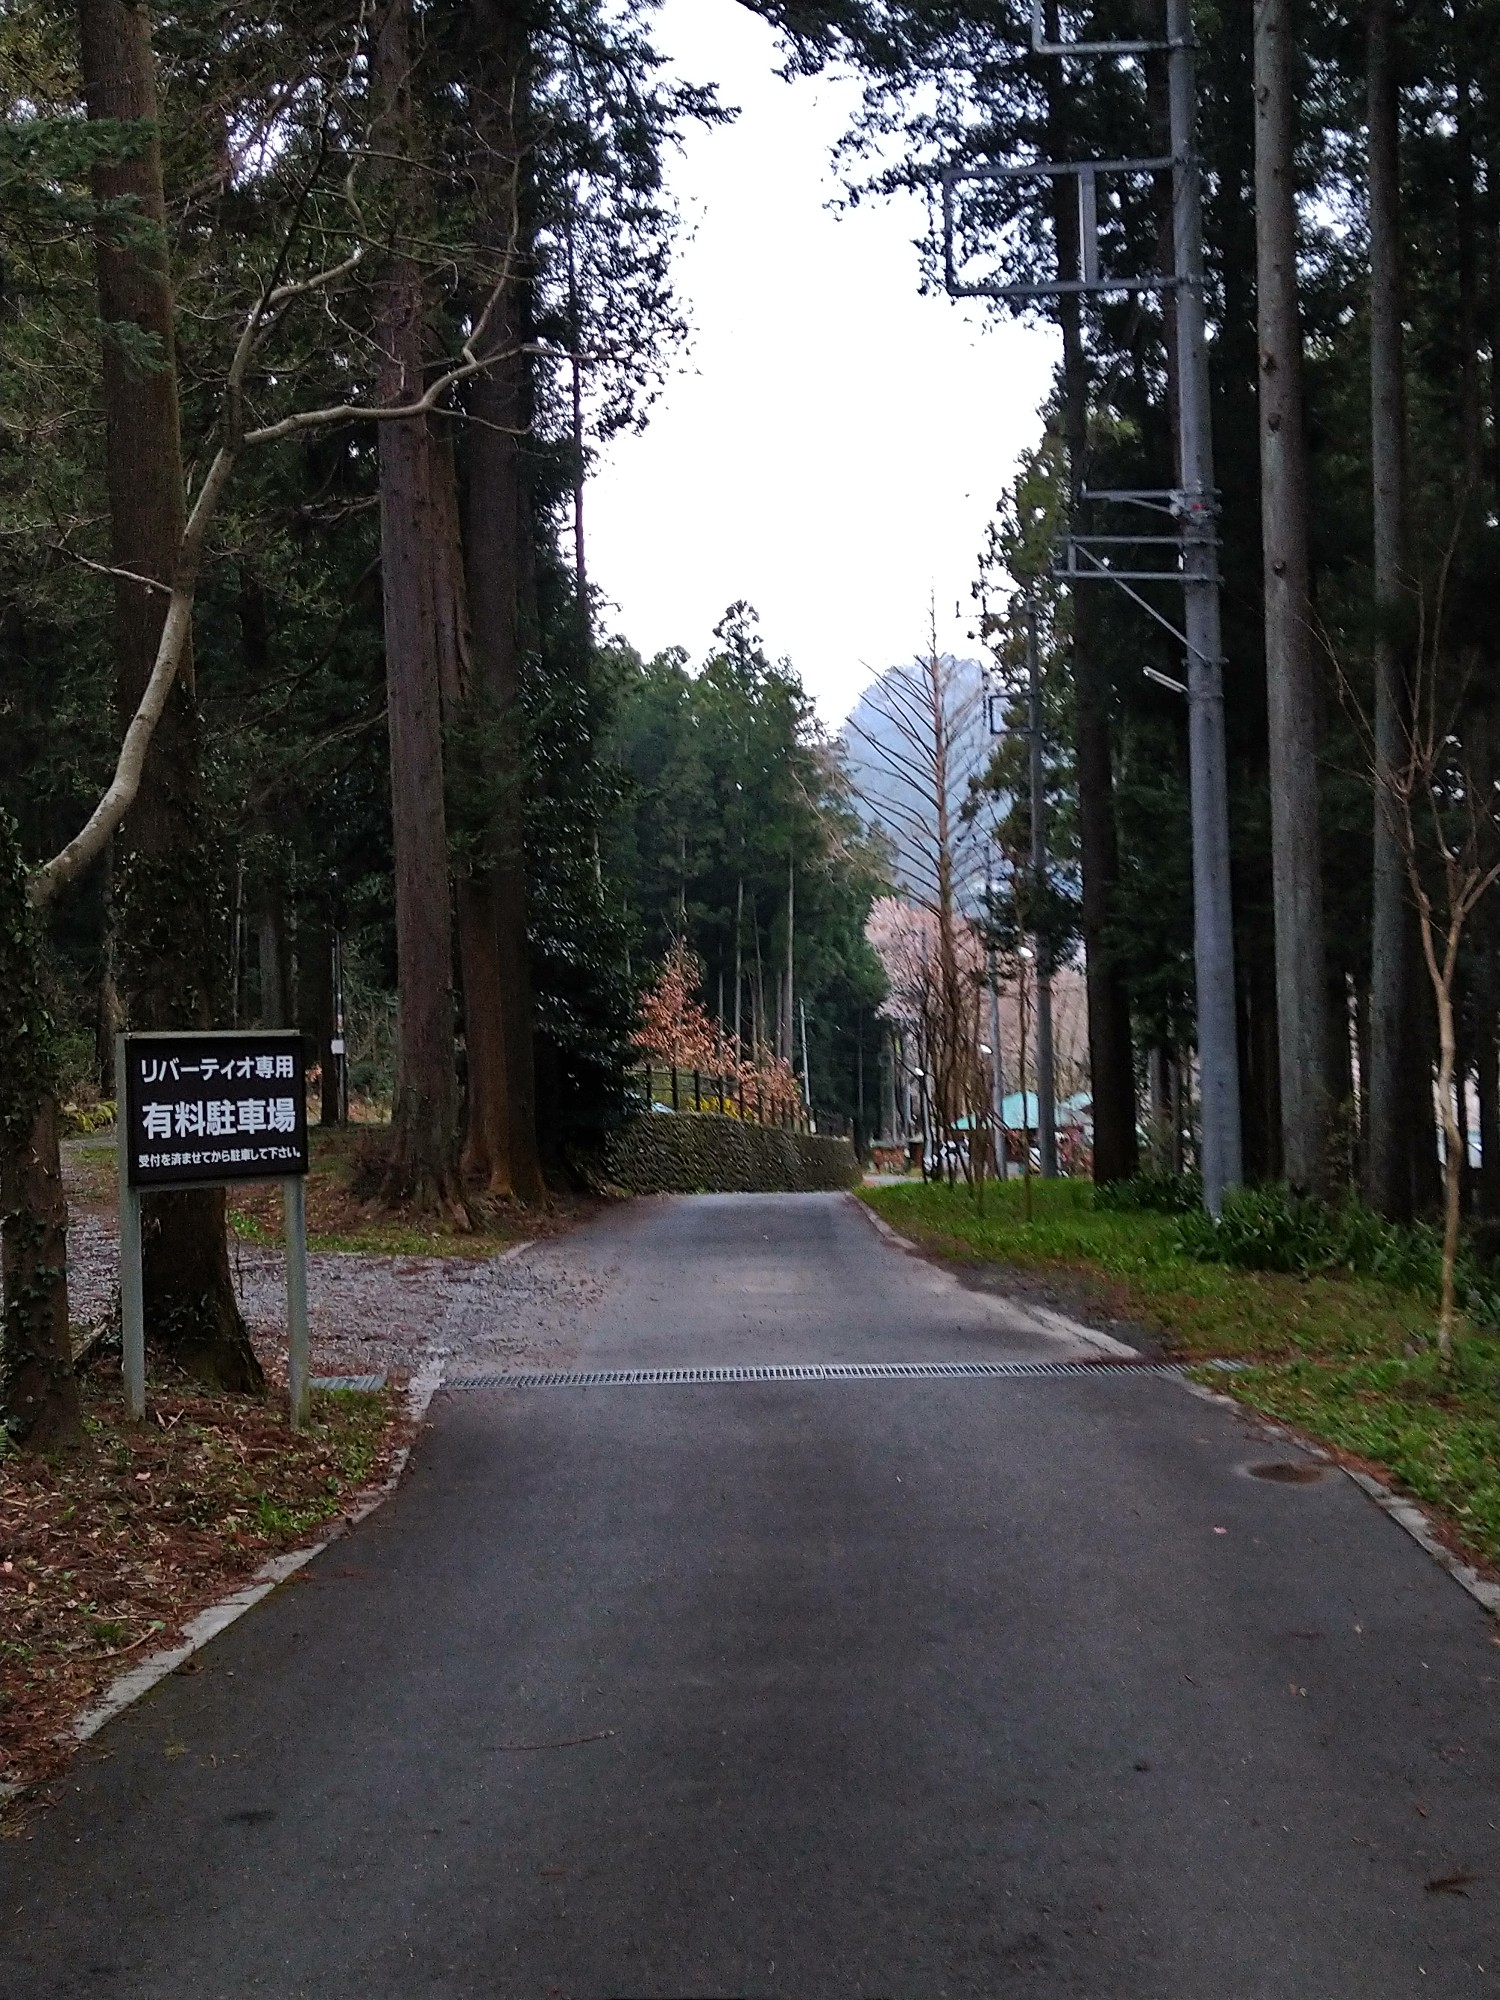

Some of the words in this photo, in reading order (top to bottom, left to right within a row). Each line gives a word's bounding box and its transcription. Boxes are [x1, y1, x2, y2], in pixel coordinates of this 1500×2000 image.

[141, 1055, 294, 1083] リバーティオ専用
[142, 1097, 296, 1140] 有料駐車場
[138, 1146, 301, 1168] 受付を済ませてから駐車して下さい。
